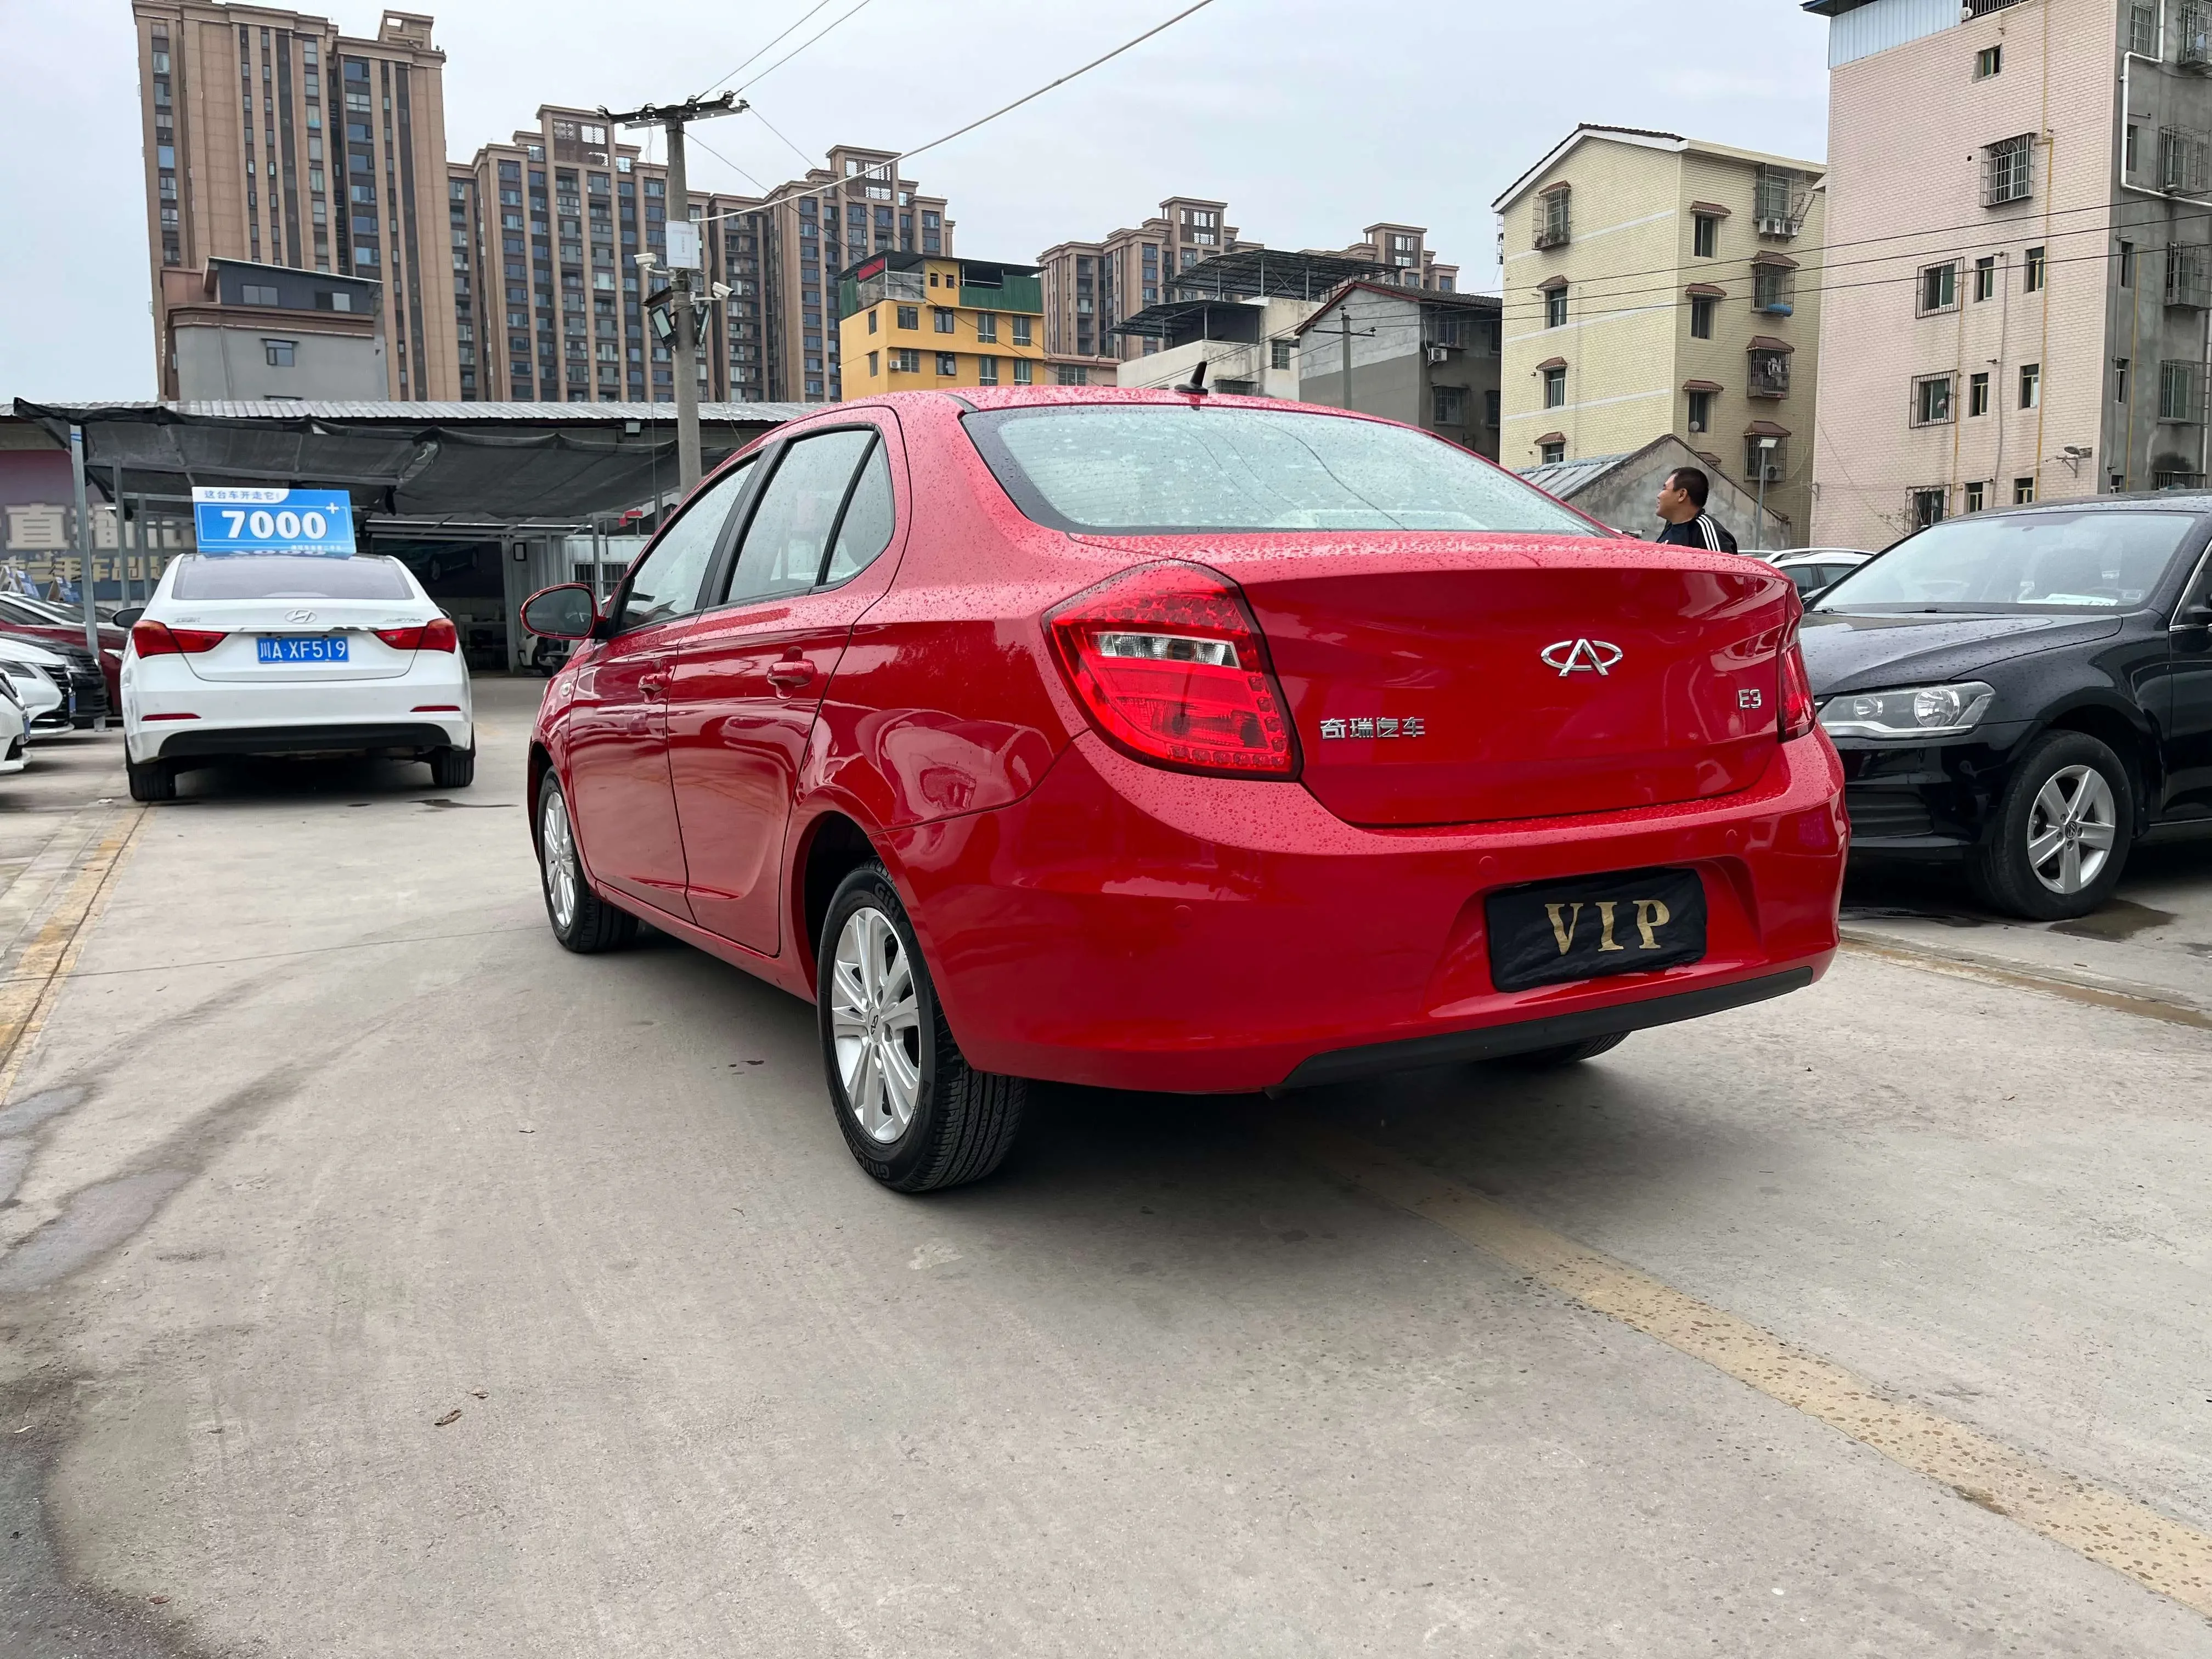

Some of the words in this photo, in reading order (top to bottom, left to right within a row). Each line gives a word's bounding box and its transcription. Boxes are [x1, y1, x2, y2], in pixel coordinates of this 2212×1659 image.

[1738, 689, 1762, 708] E3
[1320, 716, 1426, 740] 奇瑞汽车
[1544, 900, 1670, 956] VIP
